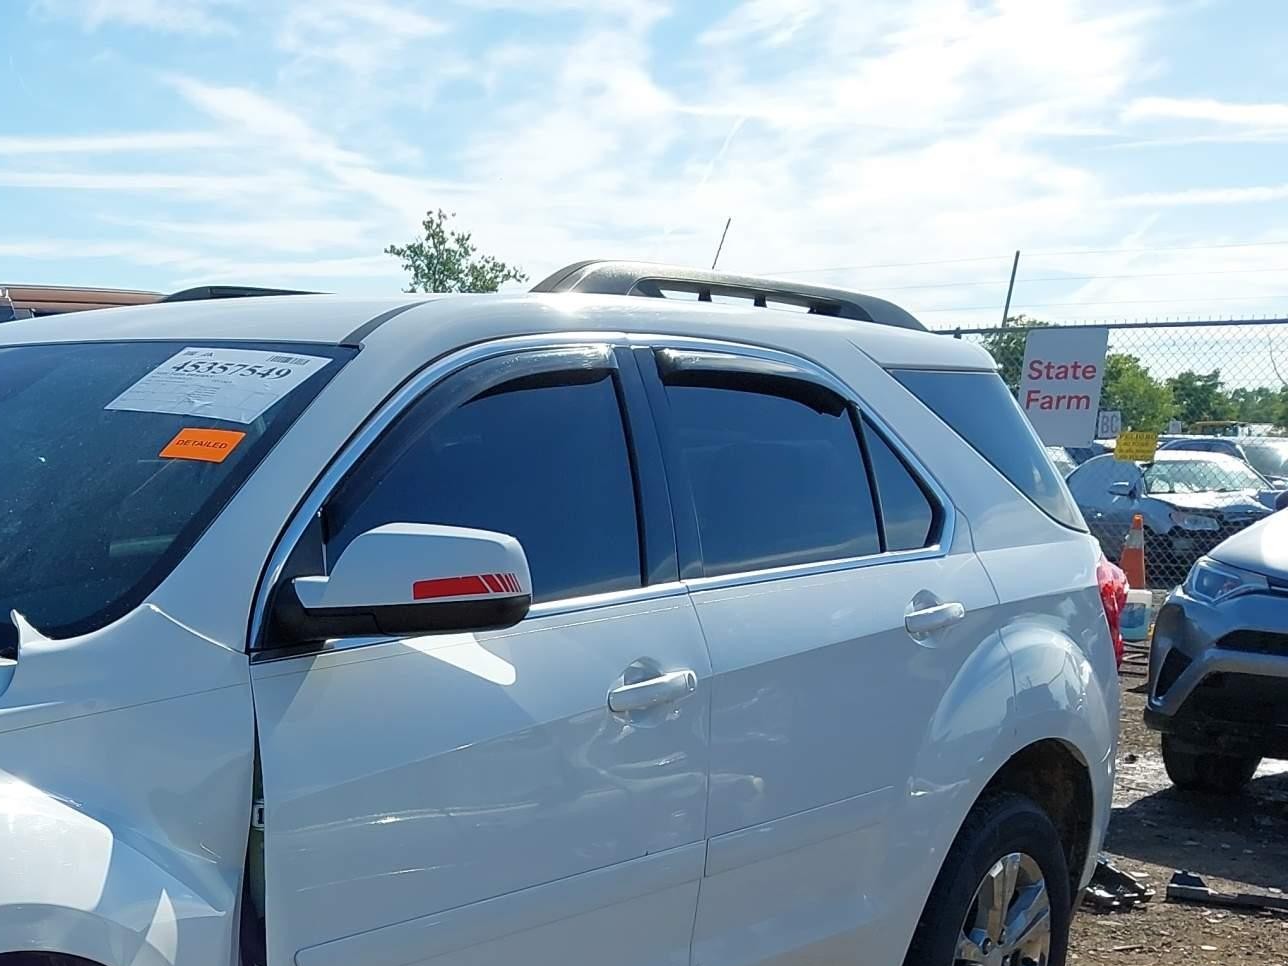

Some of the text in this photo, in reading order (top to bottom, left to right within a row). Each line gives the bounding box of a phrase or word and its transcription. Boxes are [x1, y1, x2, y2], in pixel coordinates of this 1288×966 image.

[171, 360, 293, 381] 45357549
[1027, 359, 1097, 381] State
[1025, 389, 1091, 411] Farm
[1101, 415, 1119, 434] BC
[175, 438, 229, 450] DETAILED
